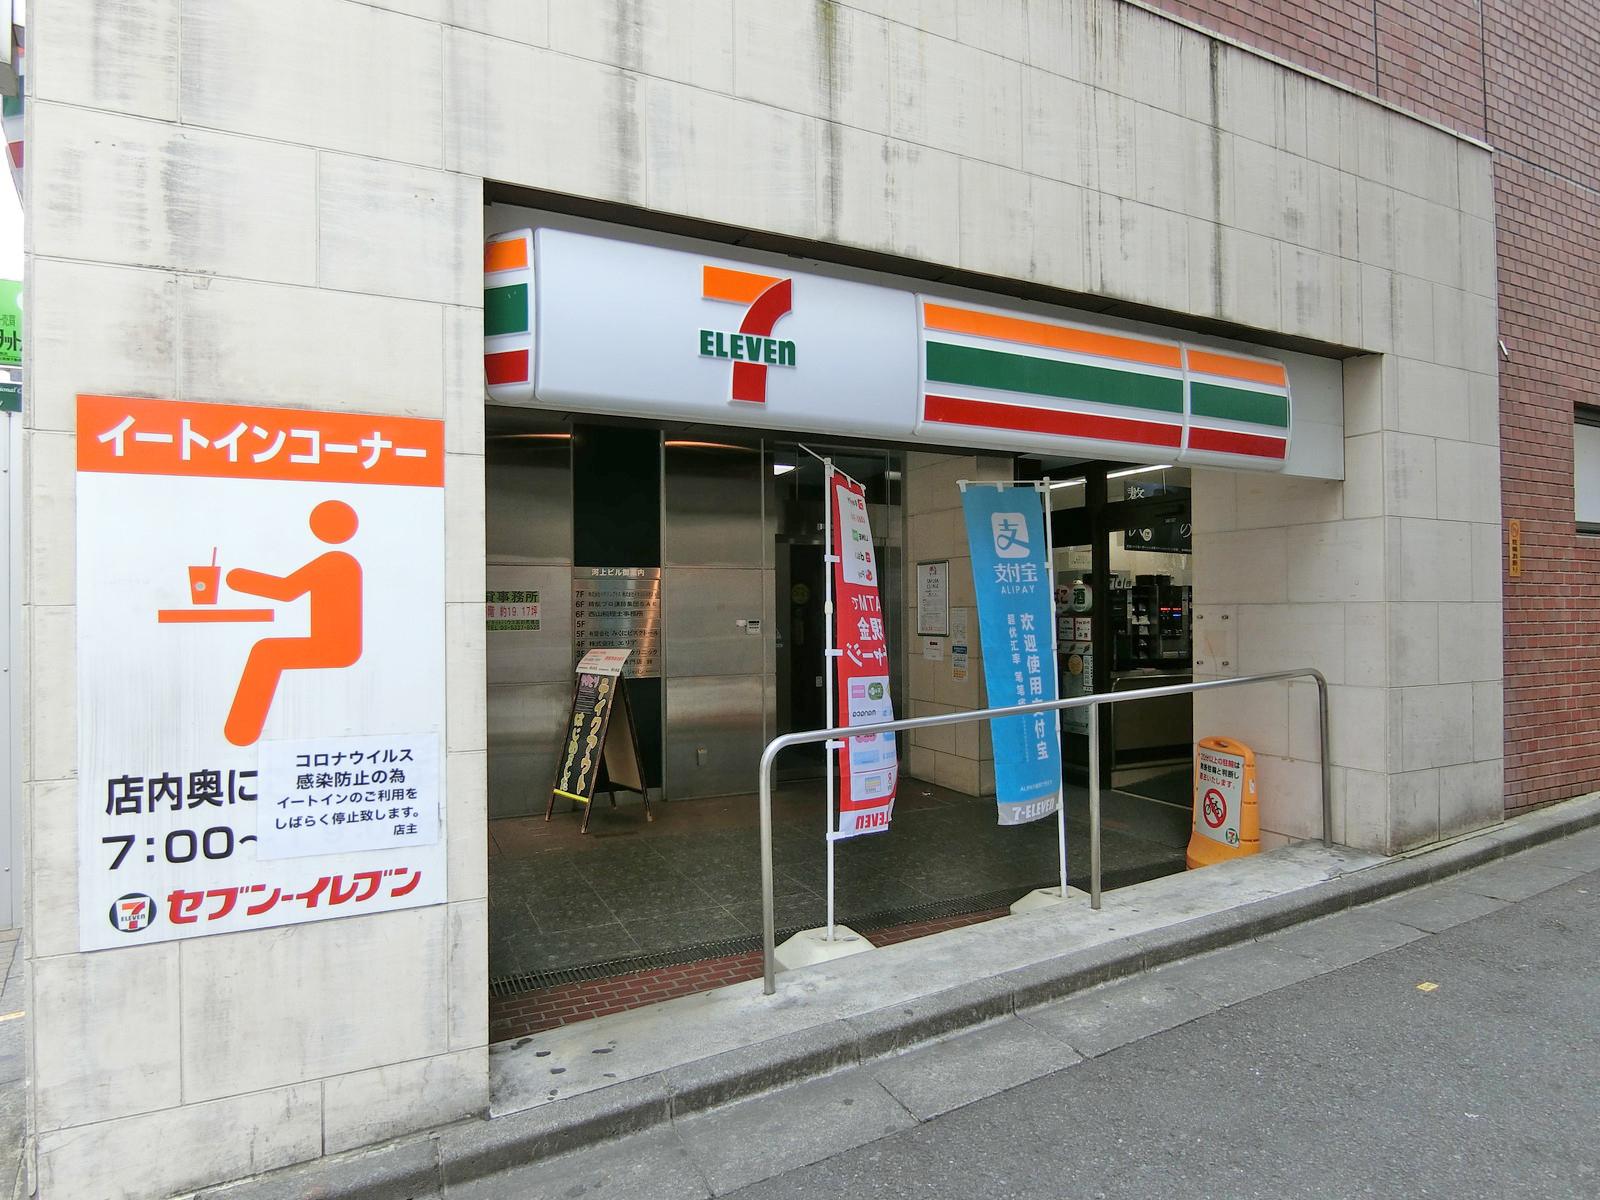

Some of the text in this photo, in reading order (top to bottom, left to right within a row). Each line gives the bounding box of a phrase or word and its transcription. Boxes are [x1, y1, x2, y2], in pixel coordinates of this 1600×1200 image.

[97, 415, 427, 469] イートインコーナー
[994, 563, 1038, 583] 支付宝
[1001, 585, 1035, 594] ALIPAY
[296, 749, 414, 768] コロナウイルス
[296, 768, 405, 790] 感染防止の為
[105, 769, 258, 815] 店内奥に
[277, 788, 418, 809] イートインのご利用を
[275, 806, 419, 830] しばらく停止致します。
[393, 823, 418, 836] 店主
